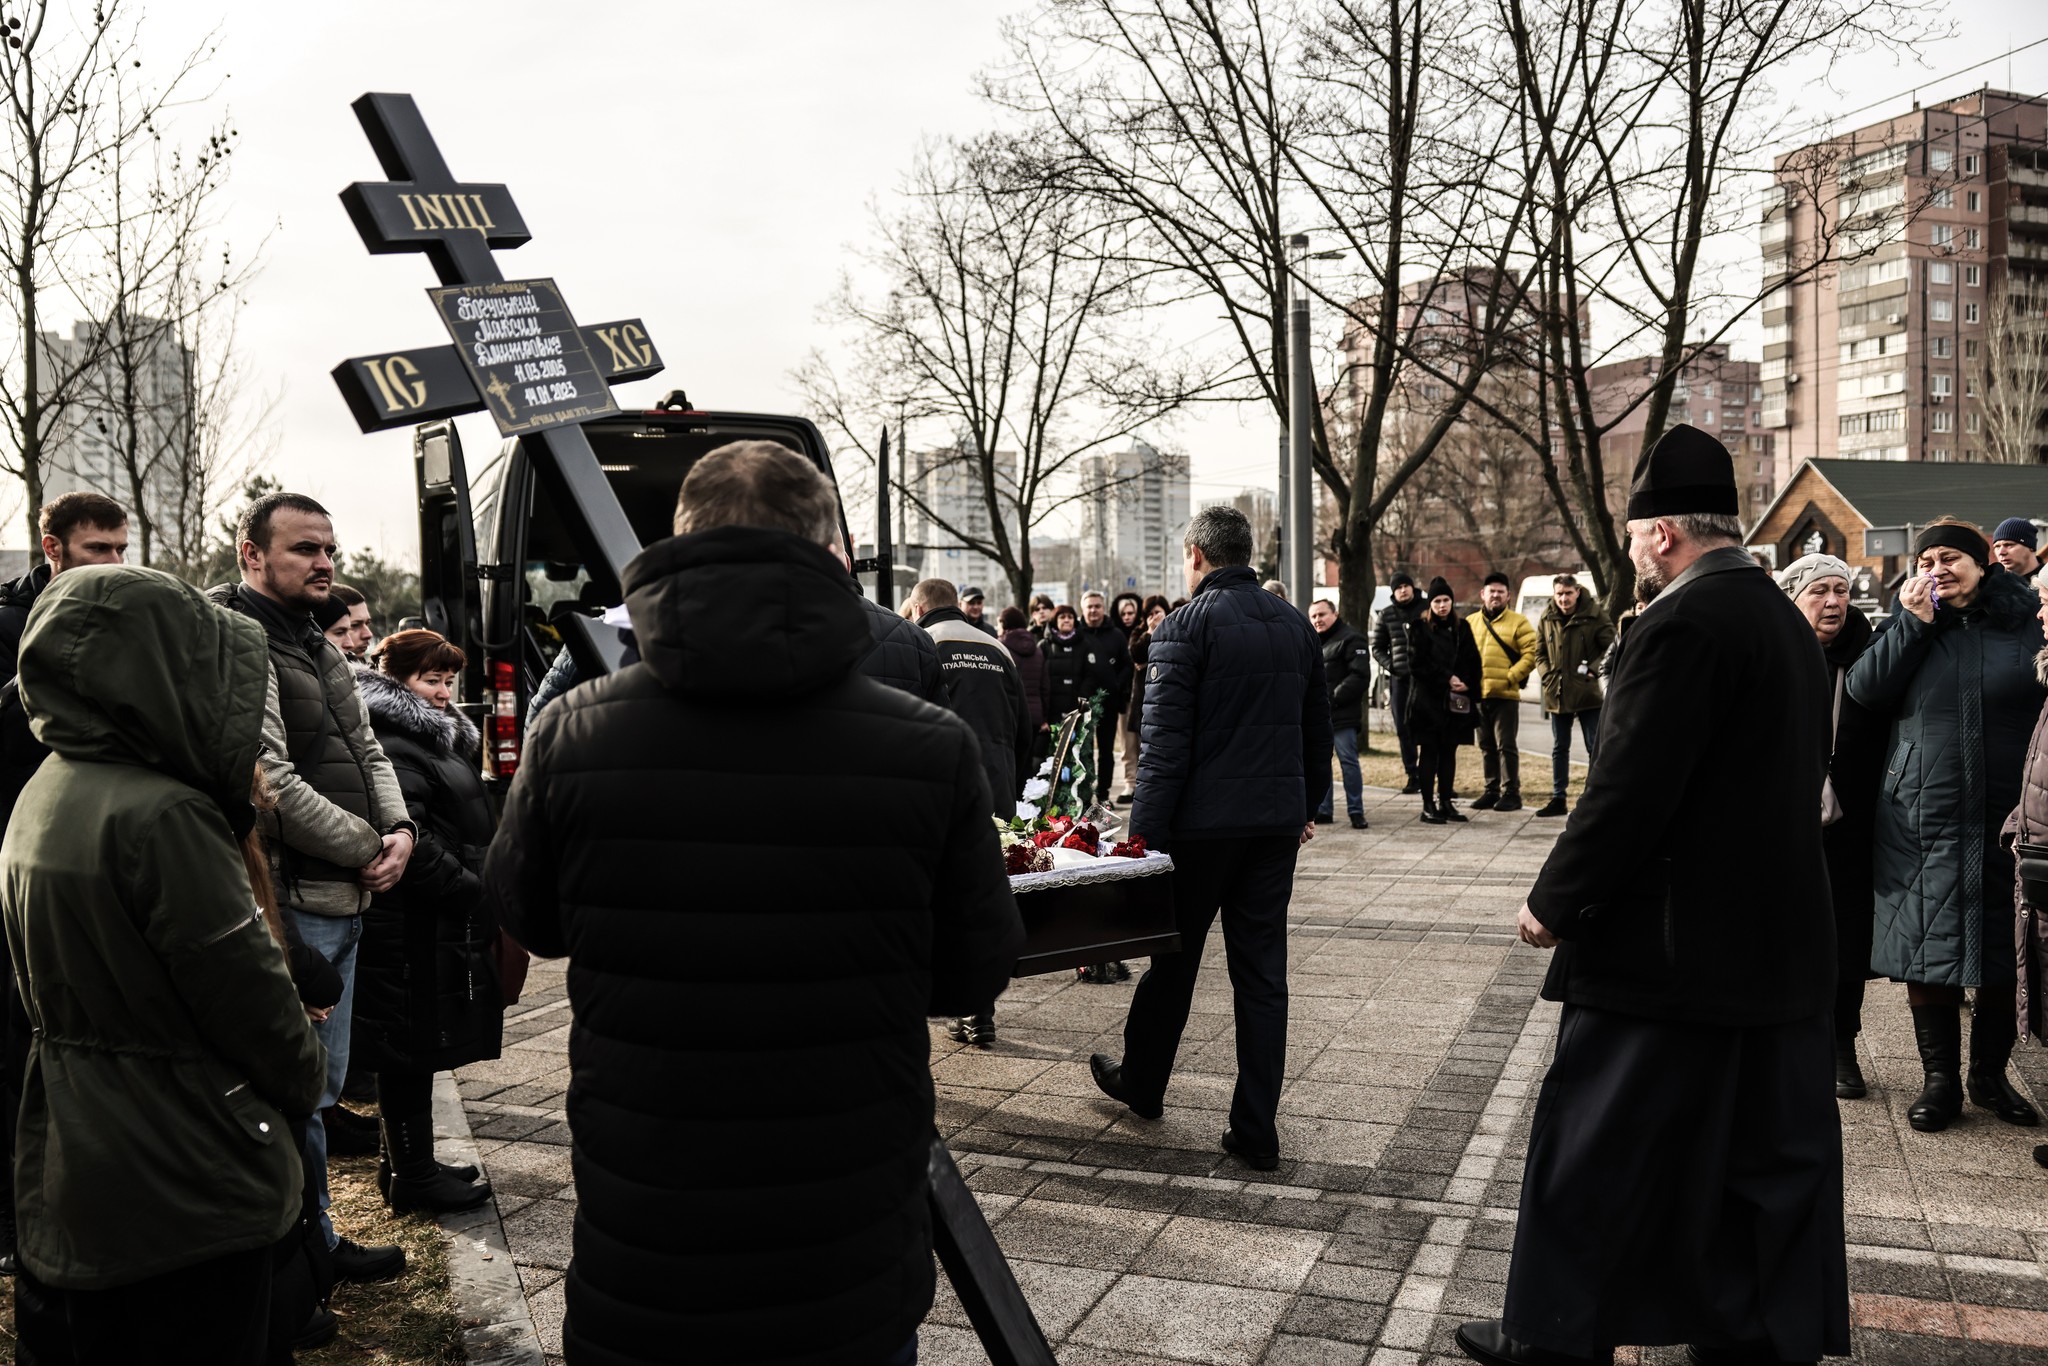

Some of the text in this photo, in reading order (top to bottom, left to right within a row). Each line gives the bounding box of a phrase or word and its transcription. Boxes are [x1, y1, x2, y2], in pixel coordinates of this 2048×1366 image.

[475, 317, 541, 342] Максим
[963, 653, 988, 662] МІСЬКА
[978, 663, 1004, 673] СЛУЖБА
